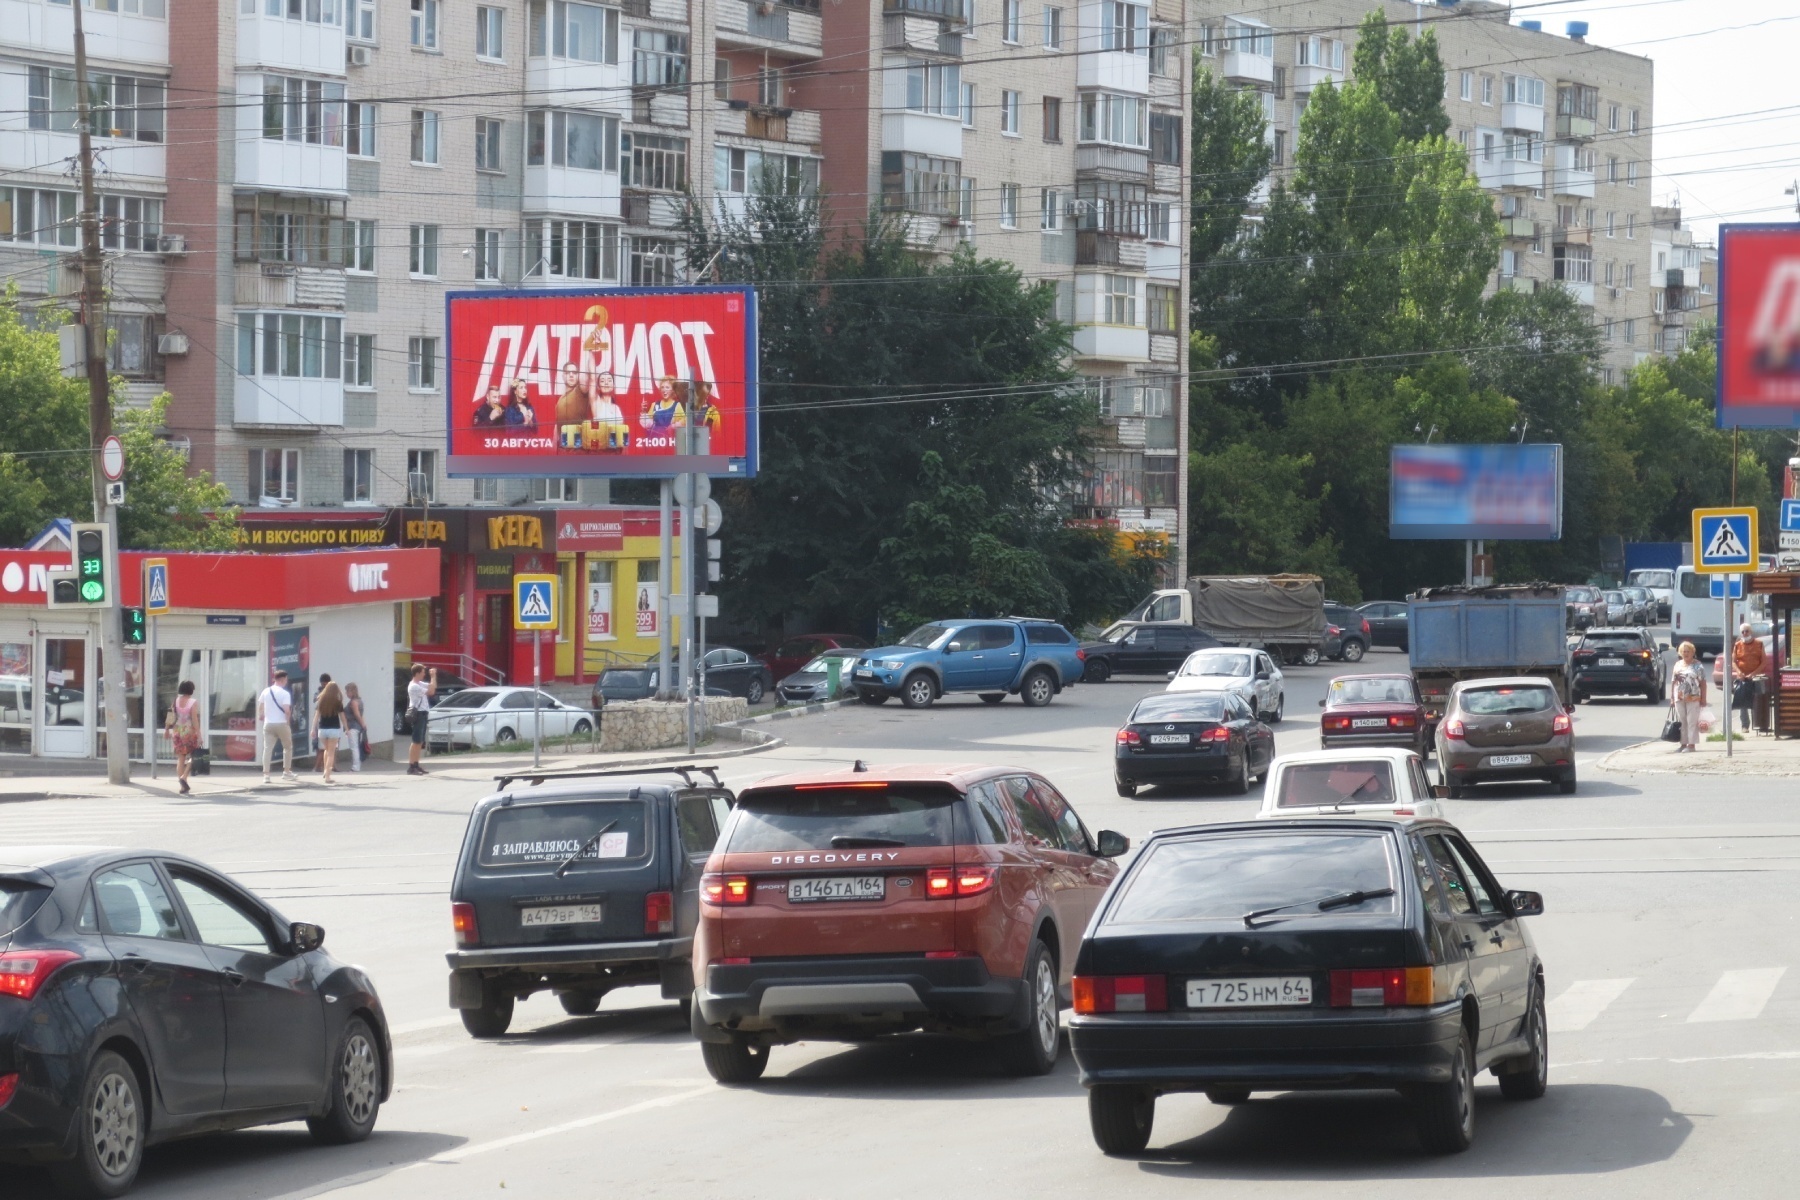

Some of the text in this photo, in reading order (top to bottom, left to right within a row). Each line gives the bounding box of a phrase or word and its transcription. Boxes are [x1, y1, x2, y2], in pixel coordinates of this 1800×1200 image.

[583, 305, 609, 351] 2
[472, 321, 721, 403] ПАТРИОТ
[484, 437, 553, 448] 30 АВГУСТА
[636, 437, 665, 447] 21:00
[252, 530, 261, 544] И
[265, 530, 335, 544] ВКУСНОГО
[338, 530, 347, 543] К
[350, 529, 385, 543] ПИВУ
[406, 520, 447, 541] КЕГА
[488, 514, 543, 549] КЕГА
[83, 560, 100, 574] 33
[477, 565, 512, 575] ПИВМАГ
[359, 563, 388, 590] МТС
[492, 845, 500, 856] Я
[502, 840, 580, 855] ЗАПРАВЛЯЮСЬ
[771, 853, 899, 865] DISCOVERY
[793, 880, 853, 897] В146ТА
[857, 877, 880, 890] 164
[525, 906, 596, 923] А479ВР 164
[1196, 982, 1278, 1003] Т725НМ
[1282, 980, 1303, 995] 64
